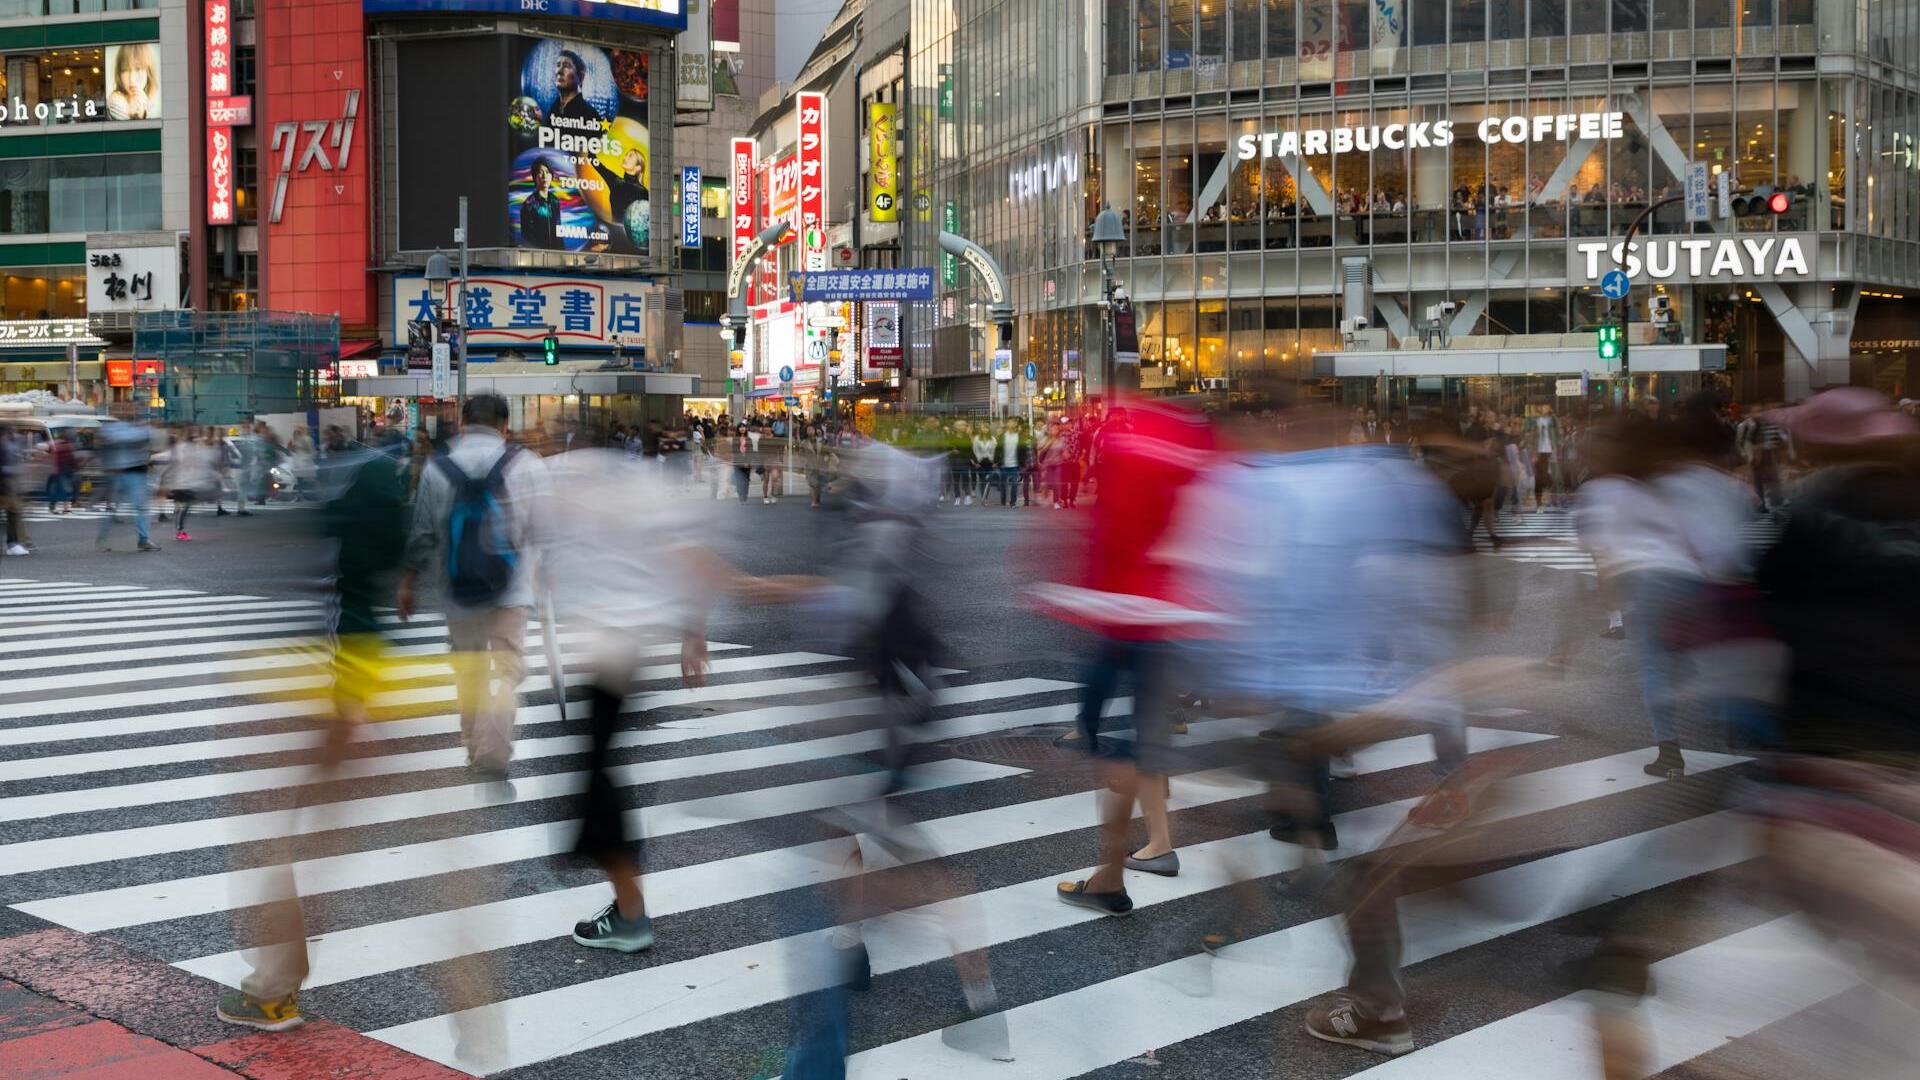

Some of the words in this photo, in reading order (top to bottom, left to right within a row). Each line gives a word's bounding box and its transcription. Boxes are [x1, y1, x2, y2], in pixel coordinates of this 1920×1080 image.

[521, 0, 549, 11] DHC
[210, 4, 228, 92] お好み焼
[550, 113, 601, 131] teamLab
[1237, 120, 1454, 160] STARBUCKS
[1477, 111, 1624, 144] COFFEE
[269, 89, 361, 223] クスリ
[538, 126, 622, 157] Planets
[801, 107, 821, 202] カラオケ
[212, 130, 229, 219] もんじゃ焼
[564, 156, 600, 167] TOKYO
[559, 177, 605, 191] TOYOSU
[876, 195, 891, 208] 4F
[555, 225, 609, 241] DMM.com
[1577, 238, 1809, 280] TSUTAYA
[806, 272, 930, 291] 全国交通安全運動実施中
[408, 287, 642, 334] 大盛堂書店
